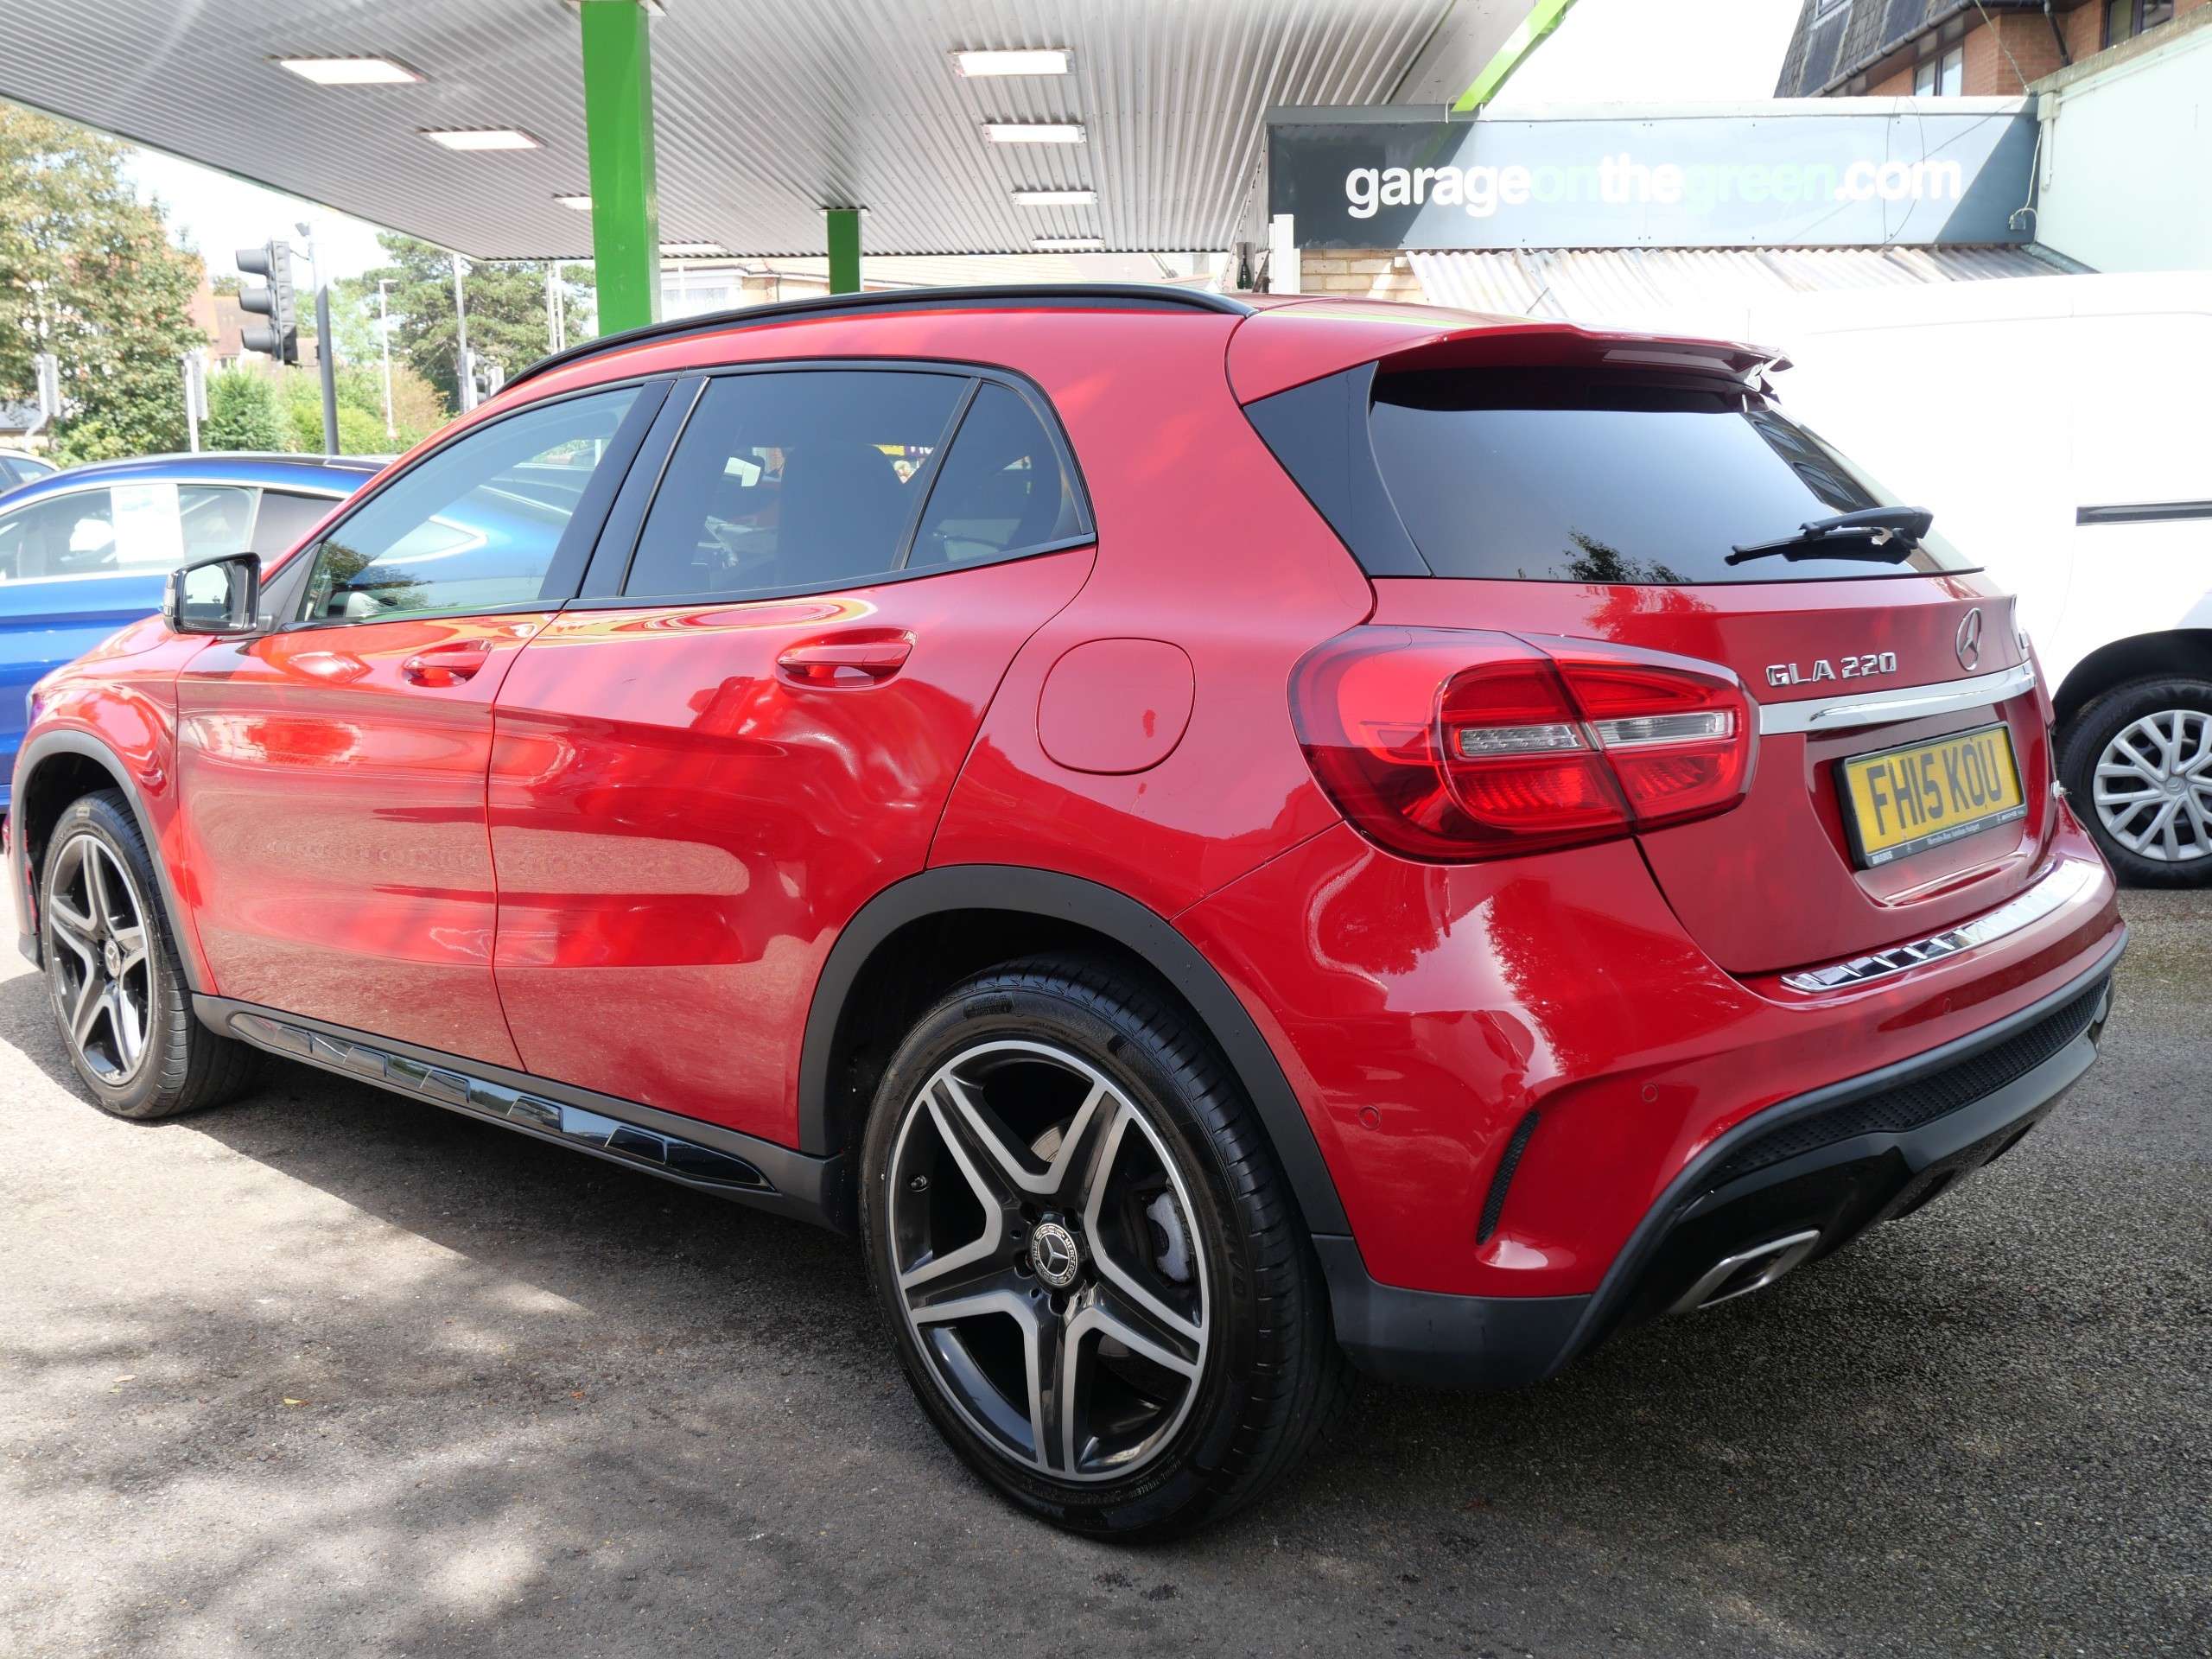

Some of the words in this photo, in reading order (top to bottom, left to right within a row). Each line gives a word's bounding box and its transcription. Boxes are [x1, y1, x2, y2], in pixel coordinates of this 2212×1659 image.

[1345, 153, 1961, 219] garageonthegreen.com
[1765, 660, 1836, 687] GLA
[1841, 652, 1897, 679] 220
[1866, 752, 1943, 836] FH15
[1942, 740, 2001, 812] KOU
